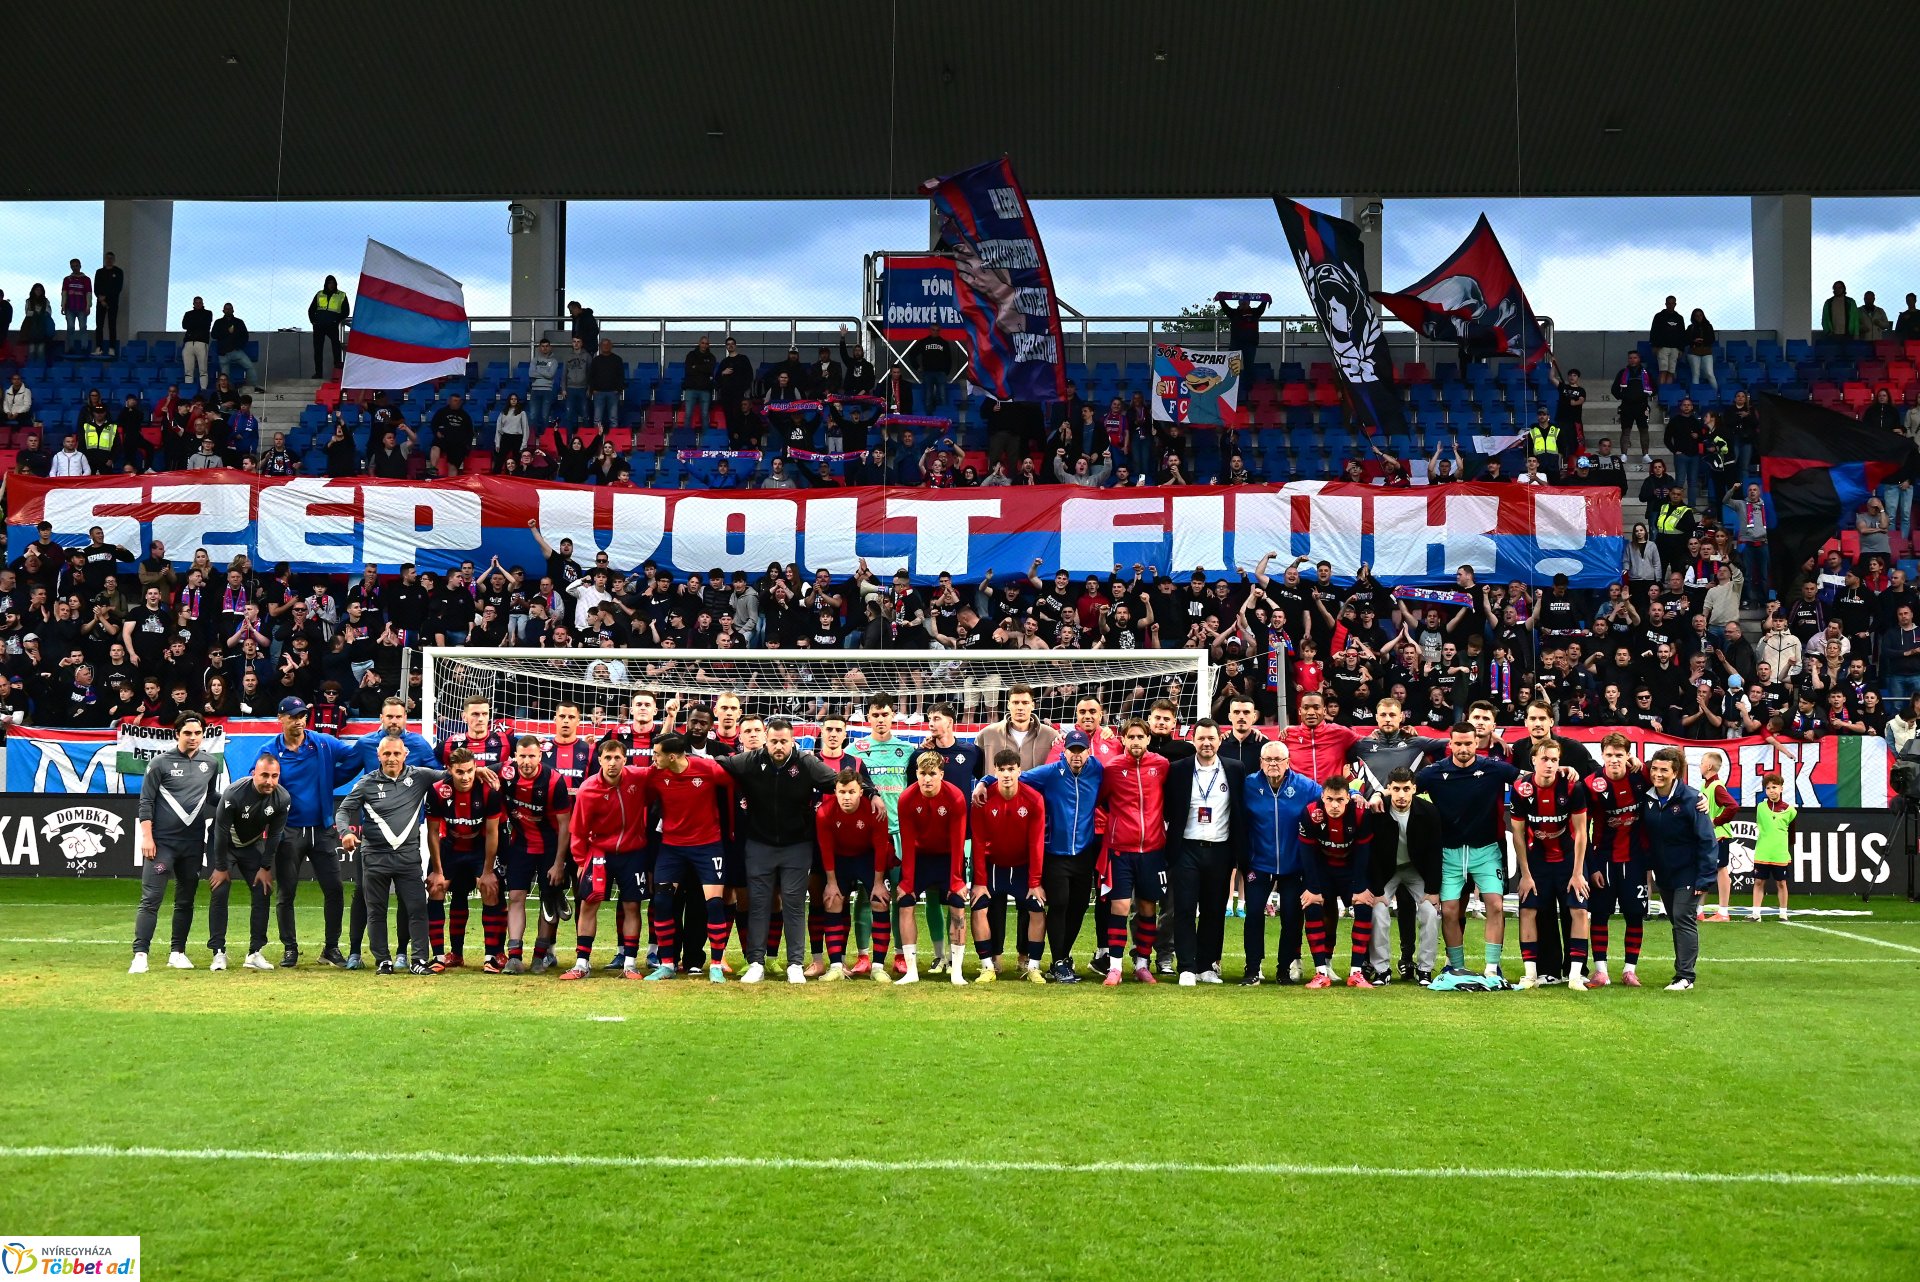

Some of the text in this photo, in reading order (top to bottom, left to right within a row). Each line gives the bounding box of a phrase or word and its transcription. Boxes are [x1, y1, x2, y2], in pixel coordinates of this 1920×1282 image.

[887, 302, 937, 324] ÖRÖKKÉ
[1157, 346, 1227, 365] SÖR & SZPARI
[44, 477, 1587, 577] SZÉP VOLT FIÚK!
[56, 808, 110, 826] DOMBKA
[1794, 823, 1890, 883] HÚS
[66, 861, 97, 869] 20 03
[712, 856, 723, 871] 17
[634, 871, 647, 886] 14
[1157, 871, 1168, 885] 11
